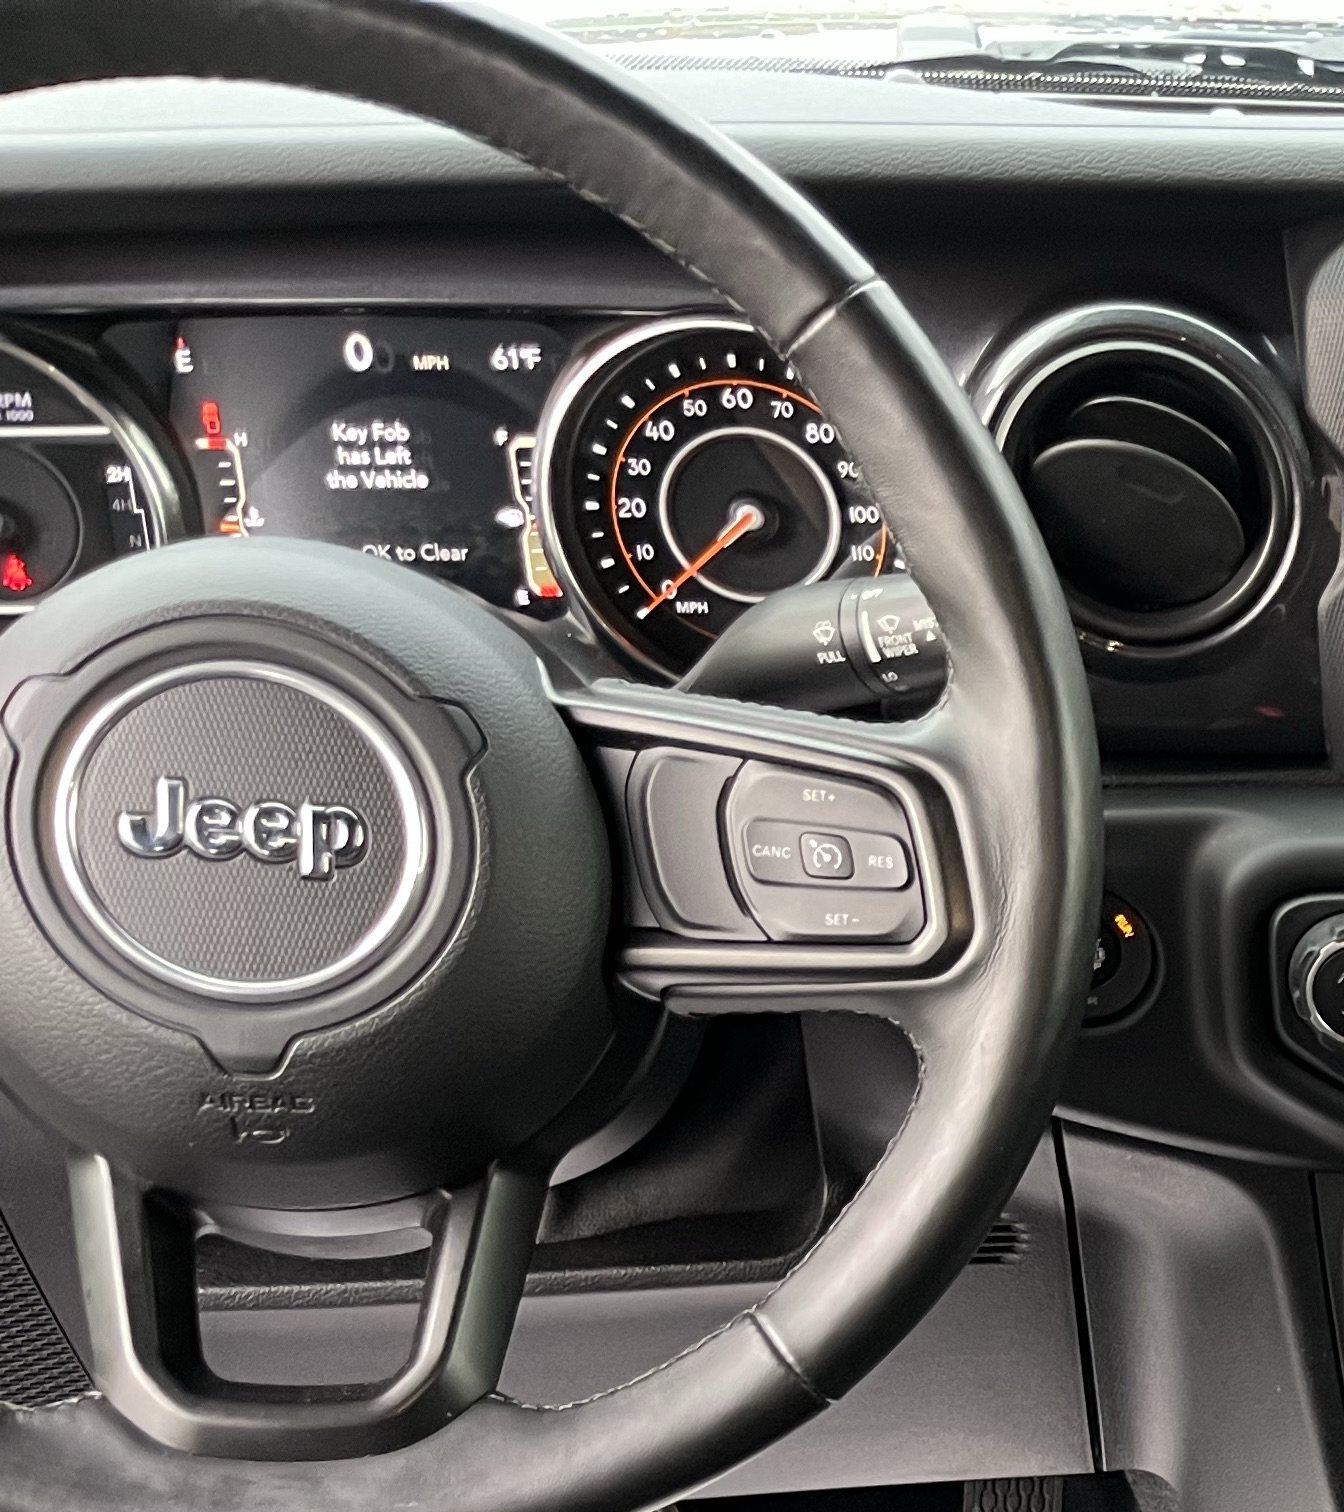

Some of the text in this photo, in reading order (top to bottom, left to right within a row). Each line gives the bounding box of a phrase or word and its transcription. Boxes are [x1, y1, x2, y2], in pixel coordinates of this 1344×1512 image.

[344, 332, 373, 371] 0
[412, 355, 450, 370] MPH
[721, 388, 753, 409] 60
[683, 399, 707, 417] 50
[770, 400, 794, 418] 70
[332, 420, 410, 445] Key Fob
[645, 420, 675, 441] 40
[805, 422, 835, 444] 80
[337, 446, 412, 466] has Left
[106, 466, 130, 484] 2H
[627, 458, 651, 476] 30
[326, 468, 429, 489] the Vehicle
[618, 497, 647, 518] 20
[849, 505, 880, 523] 100
[395, 546, 416, 561] to
[420, 542, 469, 562] Clear
[635, 543, 655, 561] 10
[851, 545, 875, 561] 110
[676, 601, 709, 614] MPH
[878, 632, 912, 648] FRONT
[817, 650, 847, 664] PULL
[881, 643, 919, 659] WIPER
[117, 775, 368, 882] Jeep
[752, 844, 792, 859] CANC
[868, 855, 894, 870] RES
